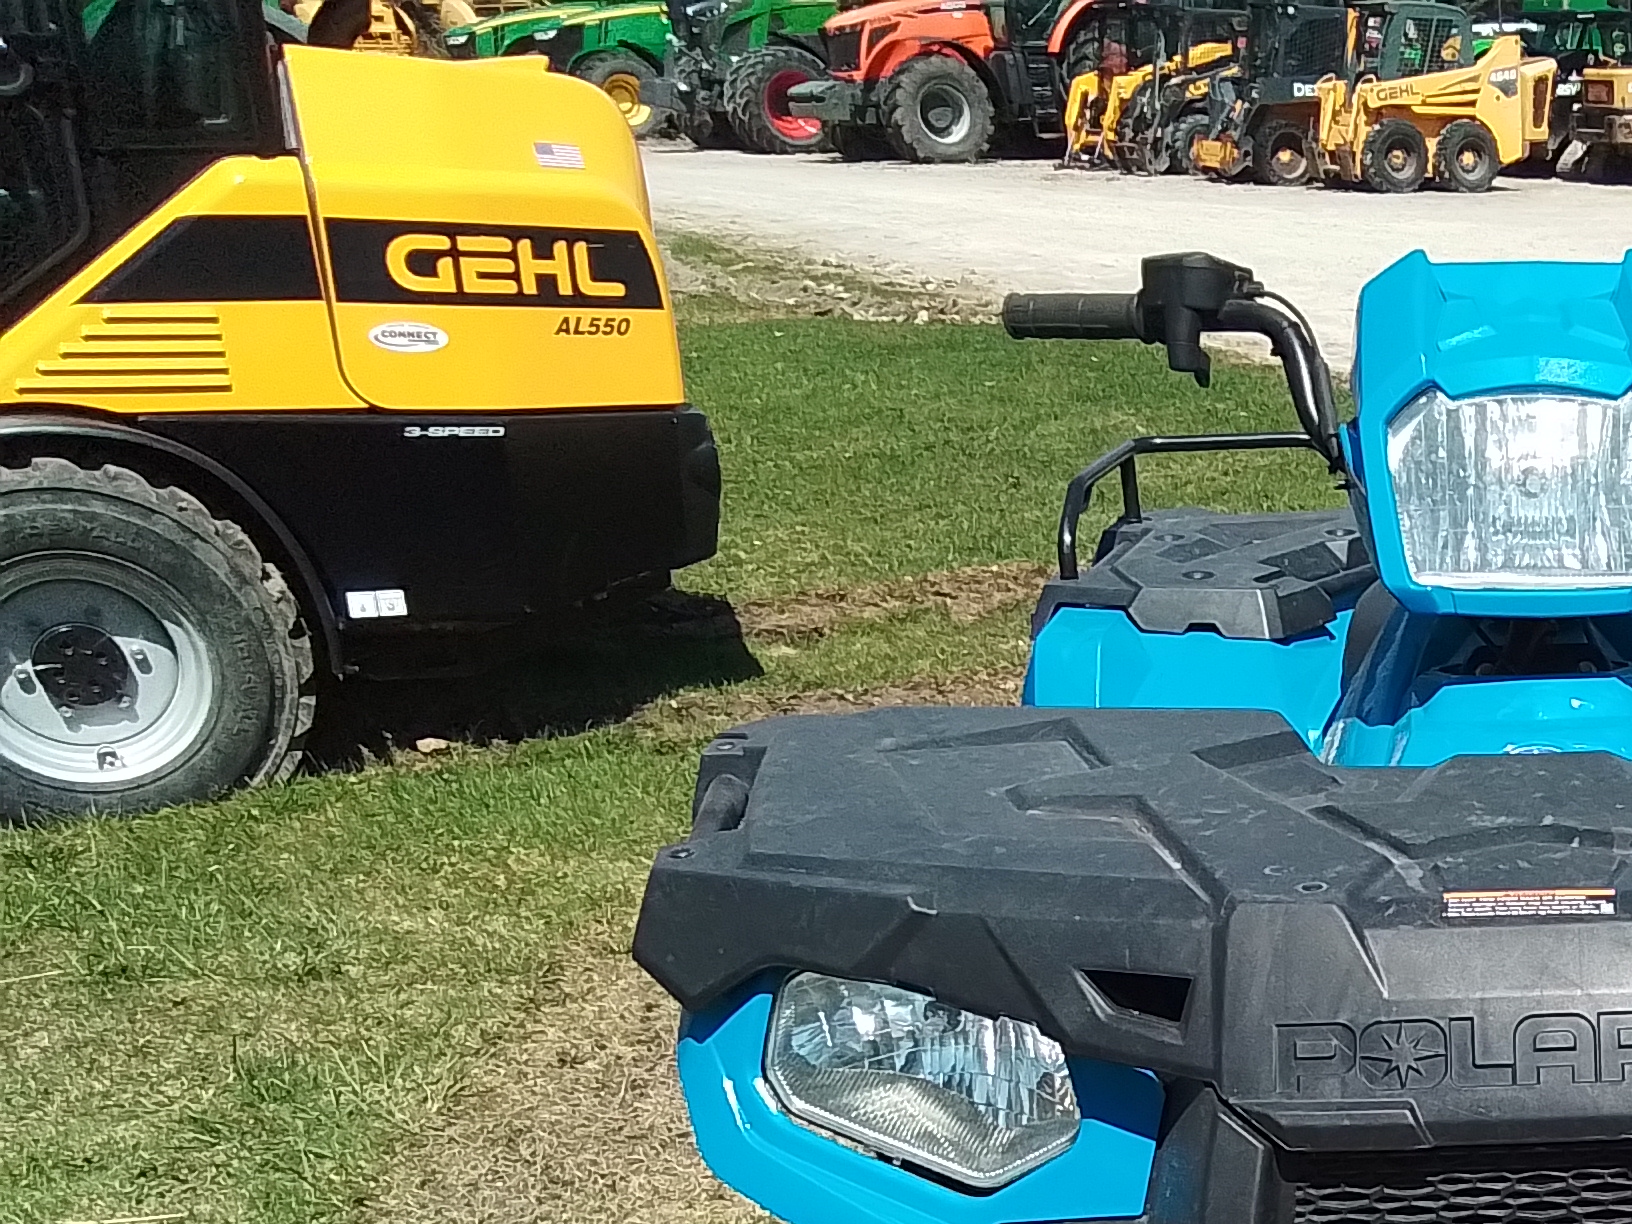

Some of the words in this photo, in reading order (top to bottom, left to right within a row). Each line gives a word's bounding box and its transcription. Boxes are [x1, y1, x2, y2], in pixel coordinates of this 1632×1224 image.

[1376, 84, 1420, 101] GEHL
[386, 233, 626, 297] GEHL
[380, 329, 438, 340] CONNECT
[554, 316, 631, 336] AL550
[403, 426, 505, 437] 3-SPEED
